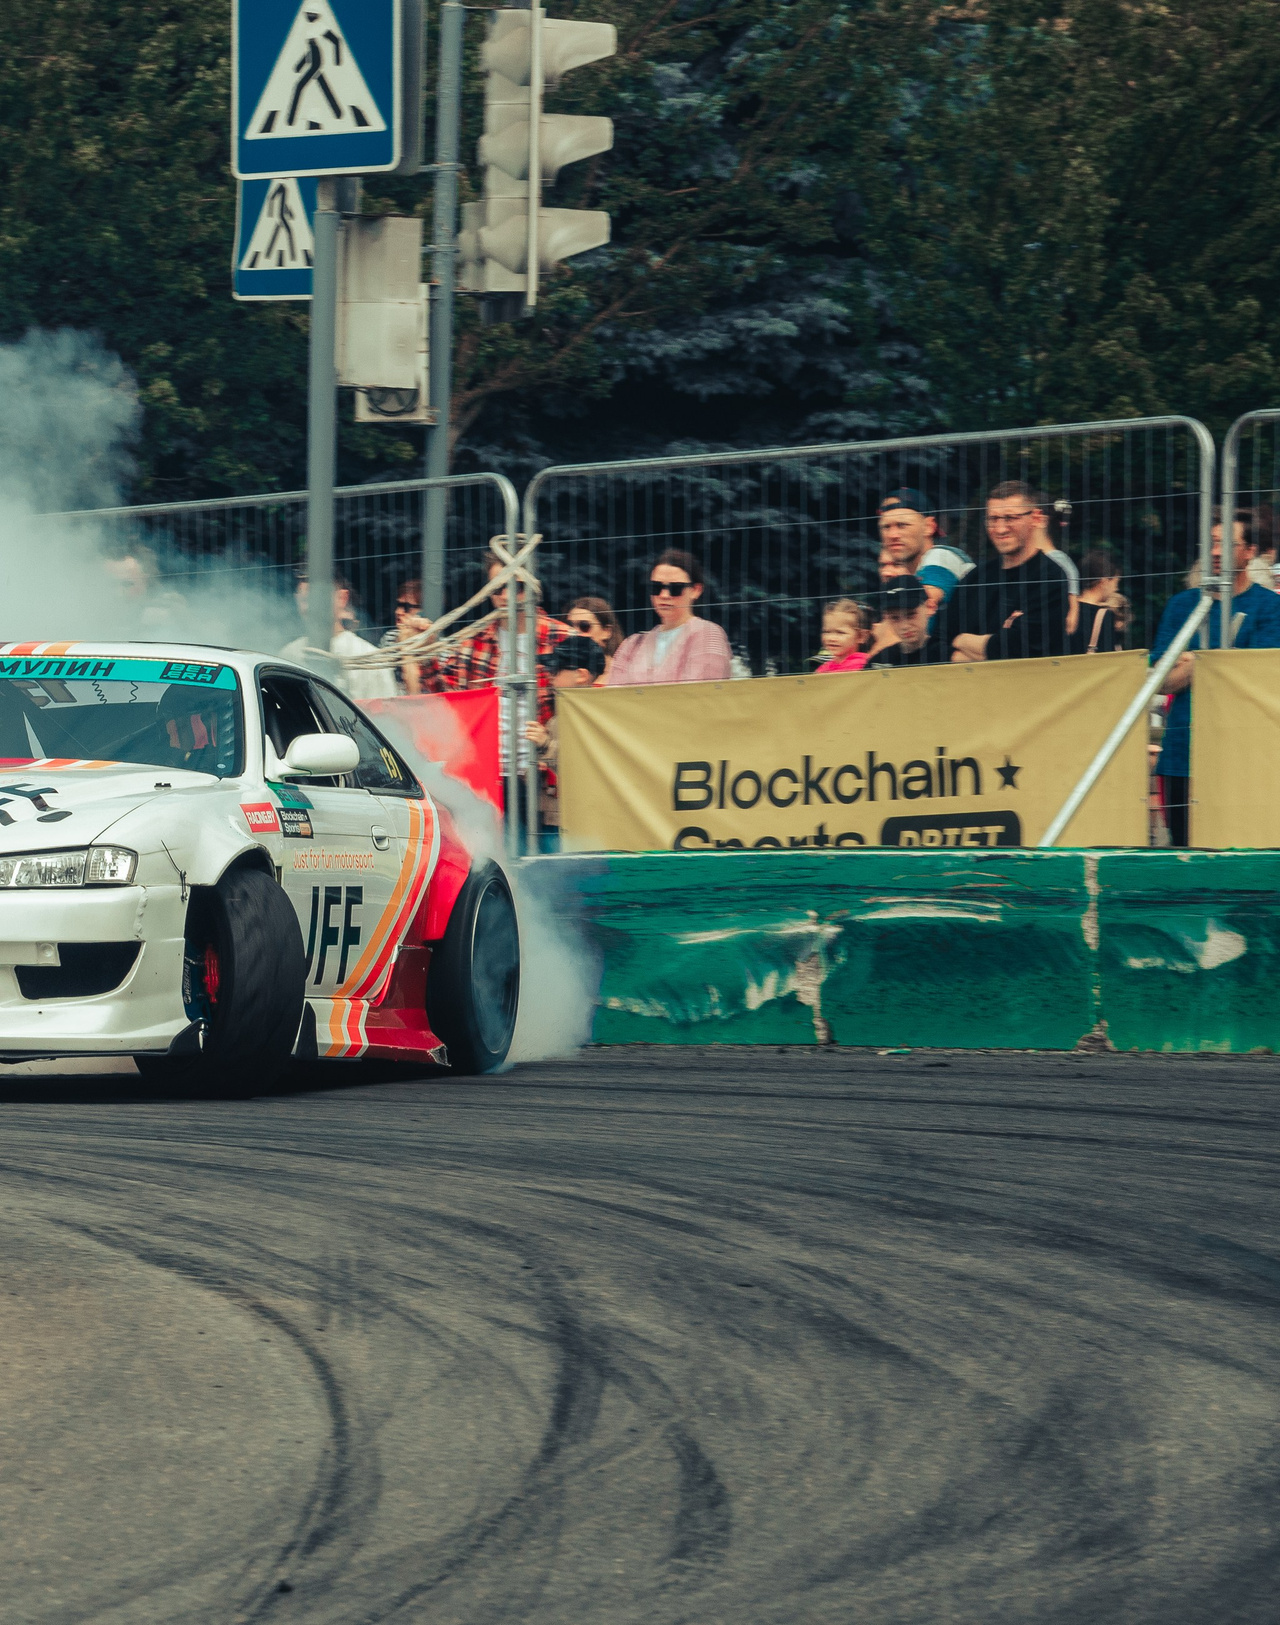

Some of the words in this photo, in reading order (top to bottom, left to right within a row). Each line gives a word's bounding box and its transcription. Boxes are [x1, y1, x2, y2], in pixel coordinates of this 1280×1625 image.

[170, 663, 217, 674] BET
[379, 747, 403, 781] 131
[673, 747, 985, 811] Blockchain
[284, 822, 300, 834] Sports
[294, 849, 309, 869] Just
[309, 848, 320, 869] for
[321, 848, 334, 869] fun
[334, 850, 375, 875] motorsport
